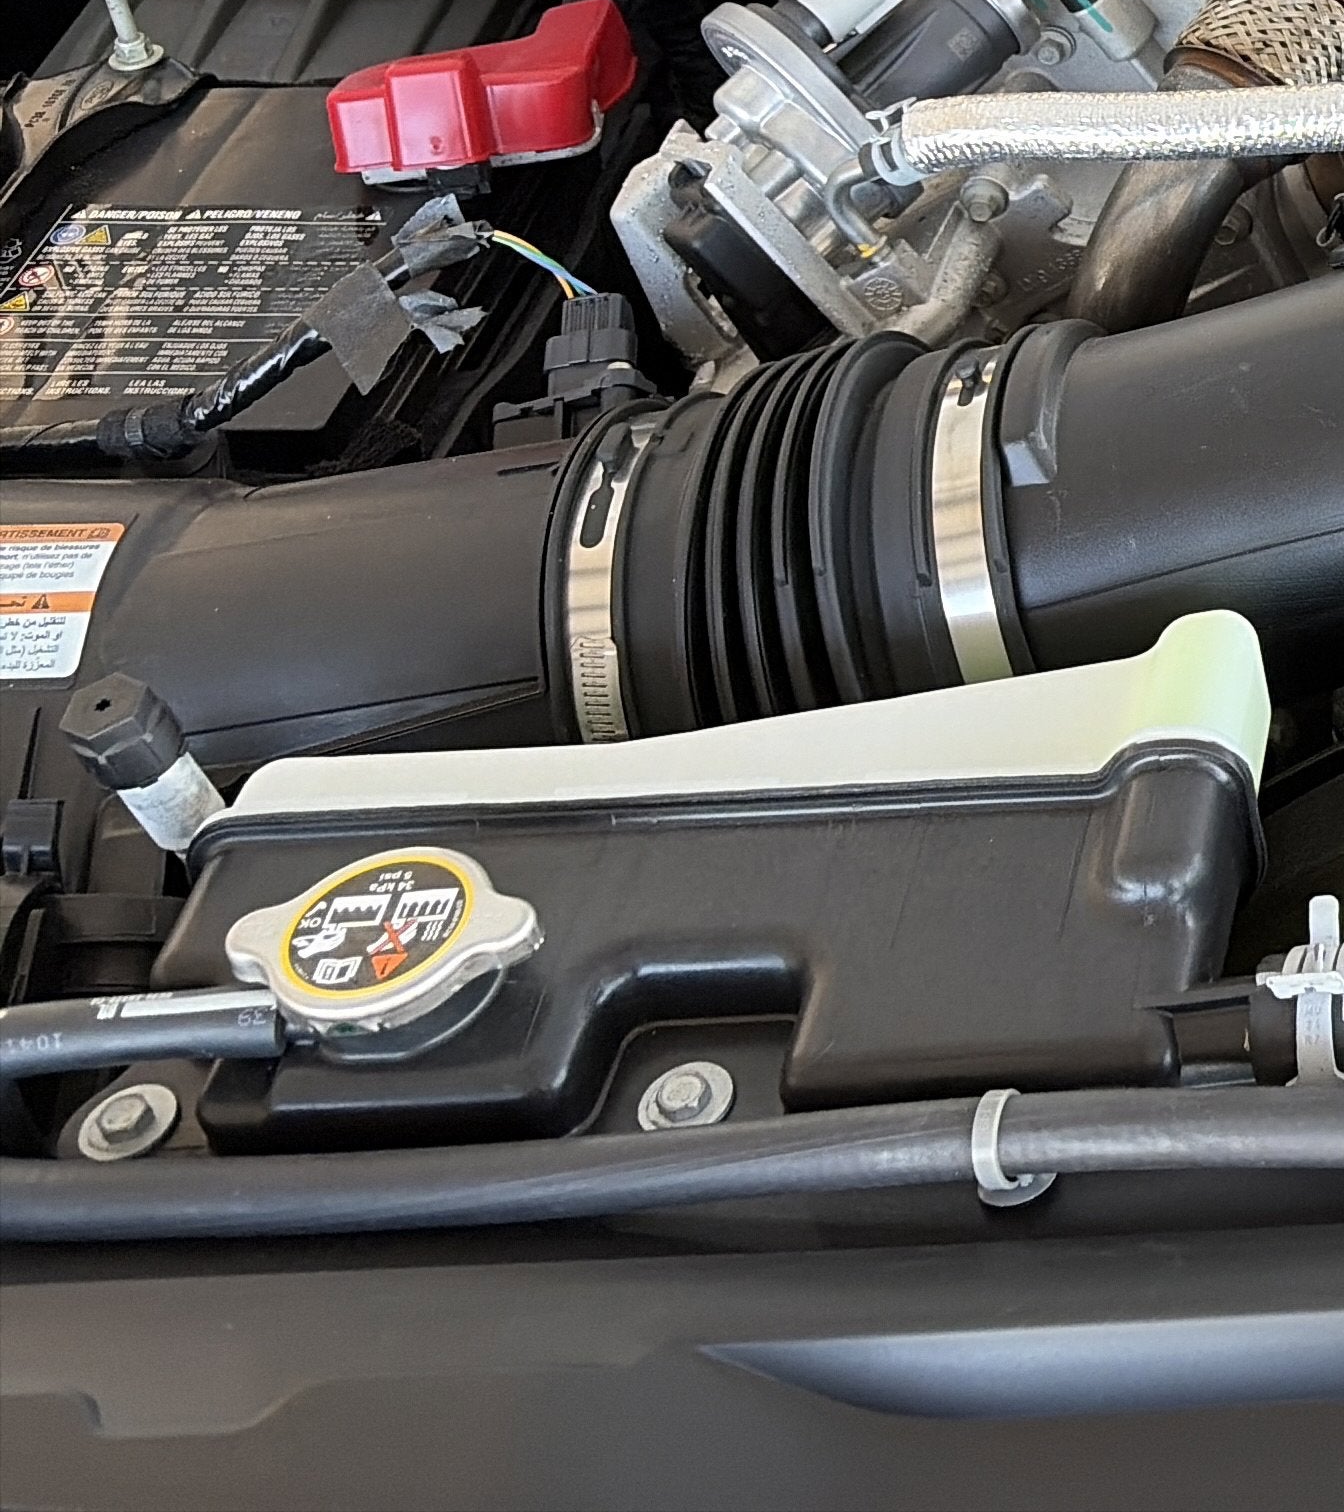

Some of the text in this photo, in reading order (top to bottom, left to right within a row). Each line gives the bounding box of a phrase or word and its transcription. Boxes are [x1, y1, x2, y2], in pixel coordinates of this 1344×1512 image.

[88, 209, 183, 220] DANGER/POISON
[202, 209, 302, 220] PELIGRO/VENENO
[379, 870, 403, 882] psi
[369, 879, 415, 893] 34 kPa
[298, 916, 322, 929] OK
